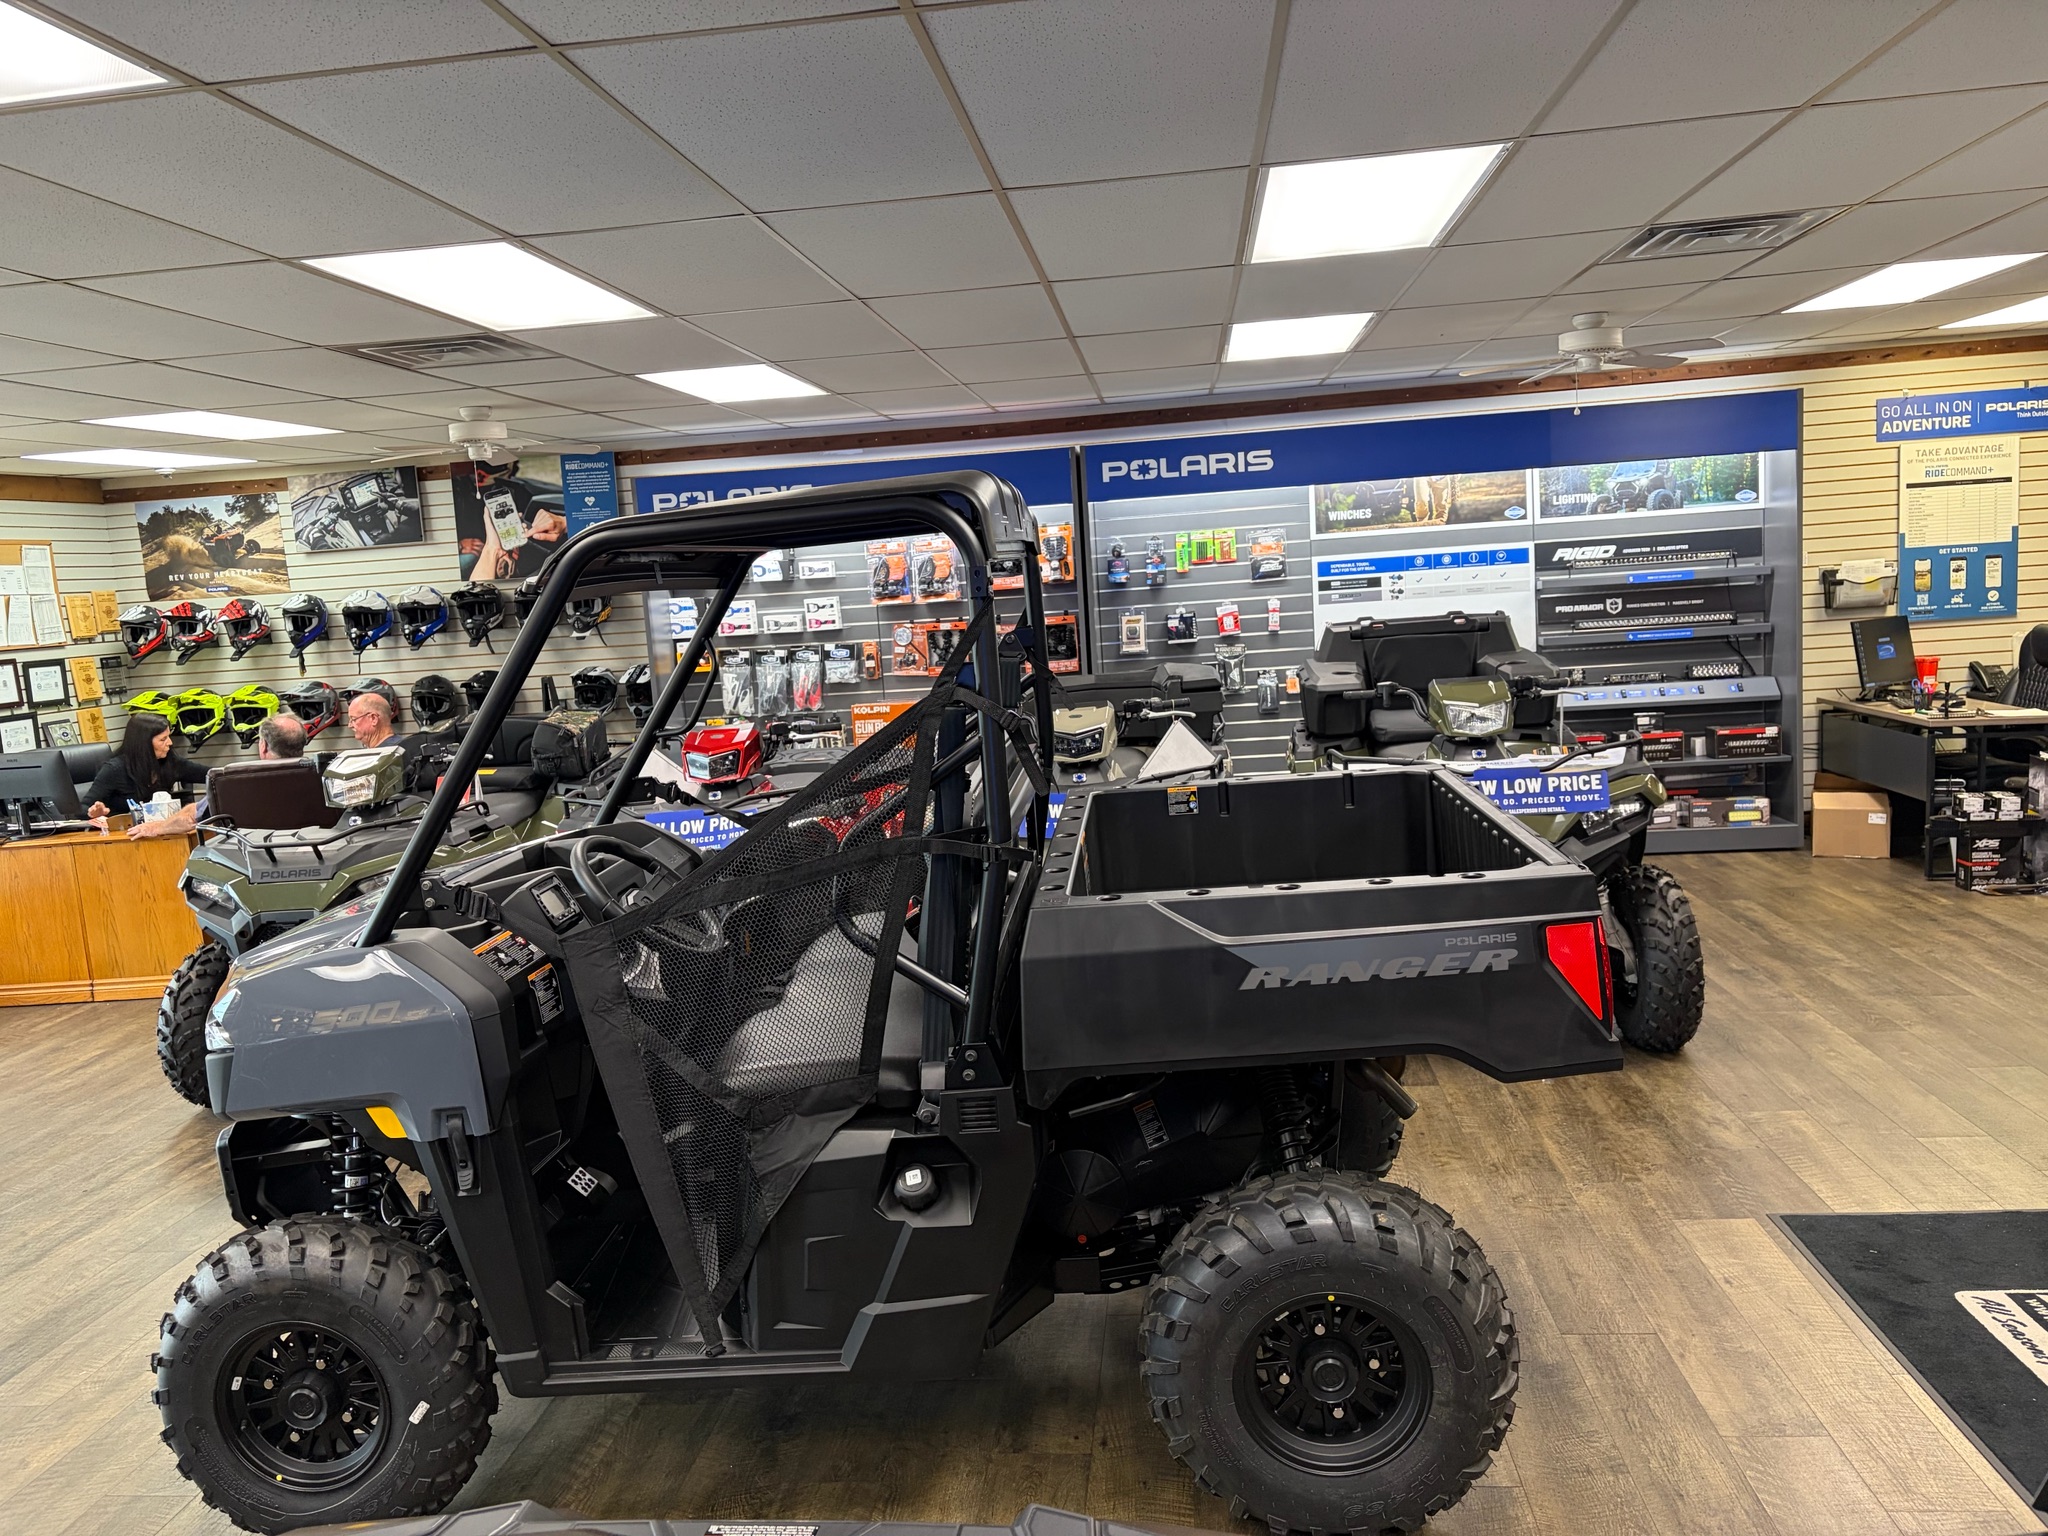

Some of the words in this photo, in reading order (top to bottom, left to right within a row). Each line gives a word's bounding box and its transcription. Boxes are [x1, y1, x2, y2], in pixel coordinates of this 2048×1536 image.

[1881, 405, 1900, 418] GO
[1904, 403, 1931, 417] ALL
[1935, 401, 1950, 414] IN
[1952, 400, 1972, 413] ON
[1986, 400, 2048, 412] POLARIS
[1882, 415, 1972, 434] ADVENTURE
[1916, 447, 1941, 458] TAKE
[1944, 444, 2004, 456] ADVANTAGE
[1102, 449, 1274, 482] POLARIS
[1925, 466, 1994, 478] RIDECOMMAND+
[652, 484, 812, 512] POLA
[1552, 492, 1598, 506] LIGHTING
[1328, 508, 1372, 522] WINCHES
[1552, 544, 1616, 562] RIGID
[1952, 546, 1978, 554] STARTED
[169, 574, 184, 582] REV
[189, 572, 210, 580] YOUR
[214, 568, 263, 578] HEARTBEAT
[1574, 604, 1604, 612] ARMOR
[854, 706, 890, 714] KOLPIN
[855, 722, 874, 734] GUN
[1504, 778, 1542, 795] LOW
[1548, 774, 1602, 792] PRICE
[1522, 796, 1556, 804] PRICED
[1574, 794, 1604, 802] MOVE.
[670, 819, 705, 835] LOW
[1972, 838, 2001, 848] XPS
[260, 869, 322, 880] POLARIS
[1445, 932, 1518, 947] POLARIS
[1238, 948, 1518, 990] RANGER
[1220, 1254, 1328, 1312] CARLSTAR
[1971, 1296, 2016, 1317] All
[182, 1292, 257, 1366] CARLSTAR
